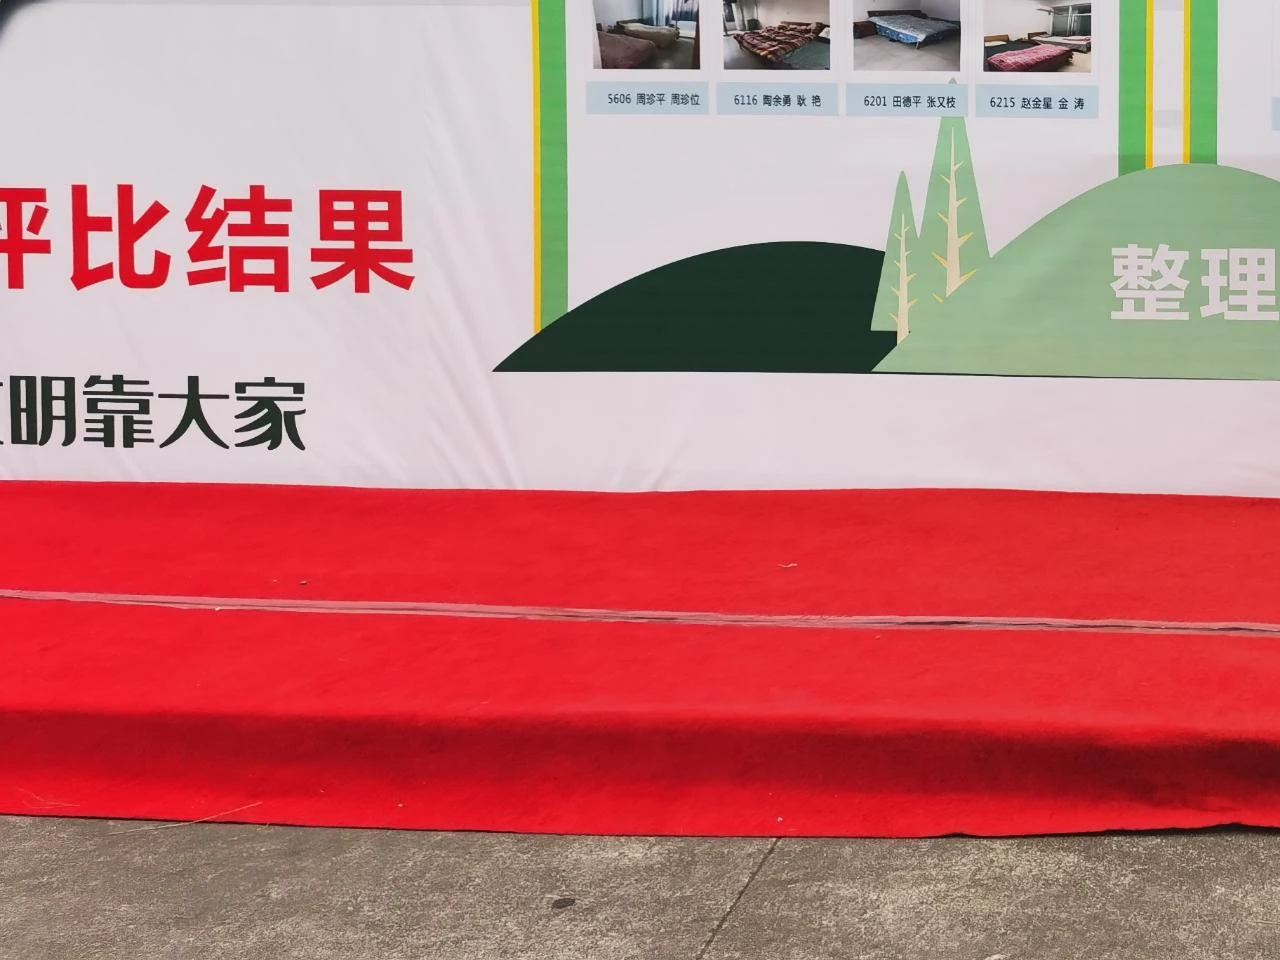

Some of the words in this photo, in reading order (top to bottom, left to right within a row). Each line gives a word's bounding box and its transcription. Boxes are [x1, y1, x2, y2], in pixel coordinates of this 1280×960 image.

[607, 93, 632, 105] 5606
[636, 92, 667, 106] 周珍平
[733, 94, 759, 106] 6116
[863, 95, 888, 107] 6201
[892, 95, 922, 109] 田德平
[926, 95, 957, 109] 张又枝
[989, 96, 1016, 108] 6215
[1020, 96, 1053, 110] 赵金星
[1109, 243, 1280, 321] 整理
[0, 374, 307, 451] 明靠大家
